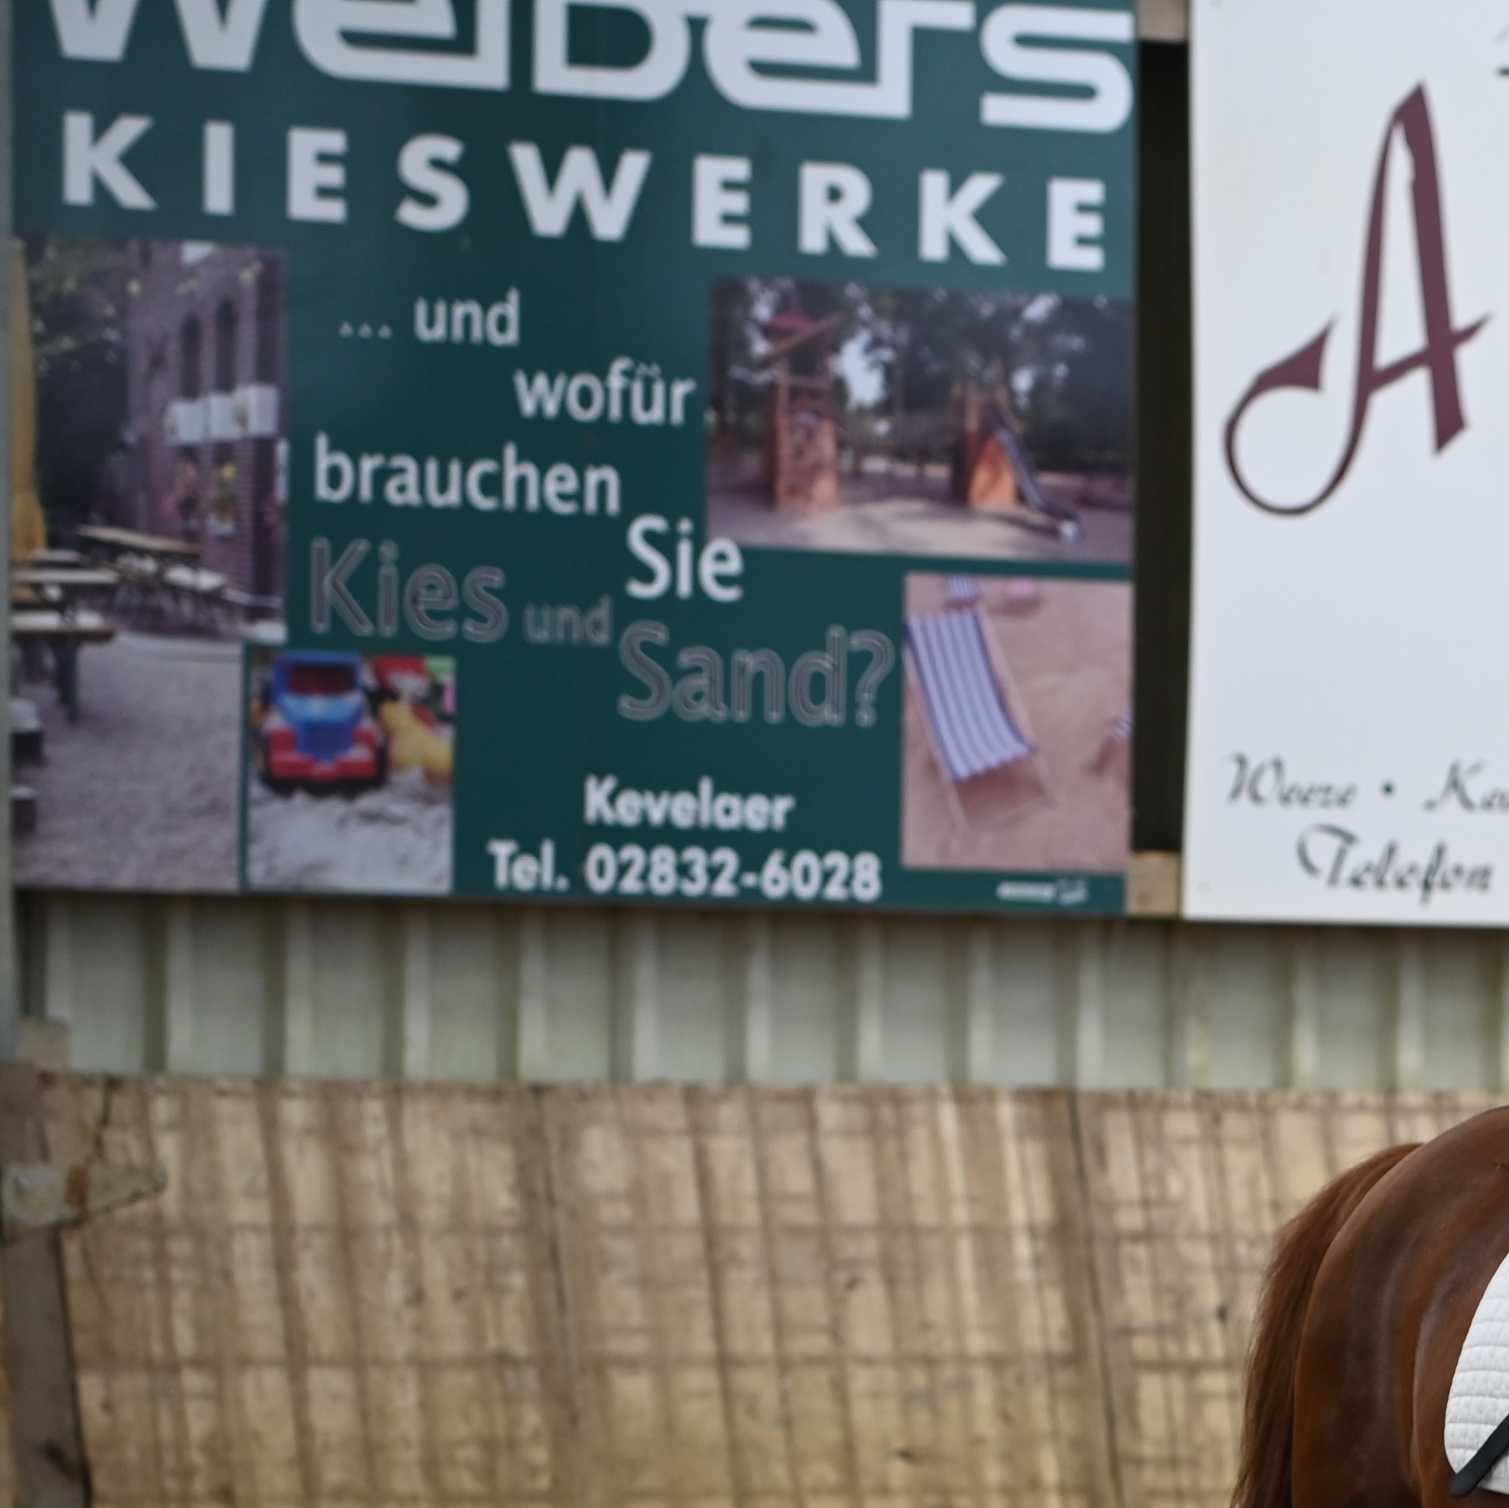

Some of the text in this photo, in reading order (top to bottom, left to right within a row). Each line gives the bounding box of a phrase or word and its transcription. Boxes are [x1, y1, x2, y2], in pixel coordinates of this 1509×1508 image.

[62, 110, 1107, 272] KIESWERKE
[413, 287, 521, 346] und
[514, 356, 697, 426] wofür
[314, 431, 621, 516] brauchen
[309, 536, 614, 647] Kies und
[626, 514, 745, 602] Sie
[617, 619, 895, 728] Sand?
[584, 774, 796, 832] Kevelaer
[1226, 751, 1358, 809] Weeze
[487, 838, 883, 902] Tel. 02832-6028
[1295, 822, 1496, 909] Telefon
